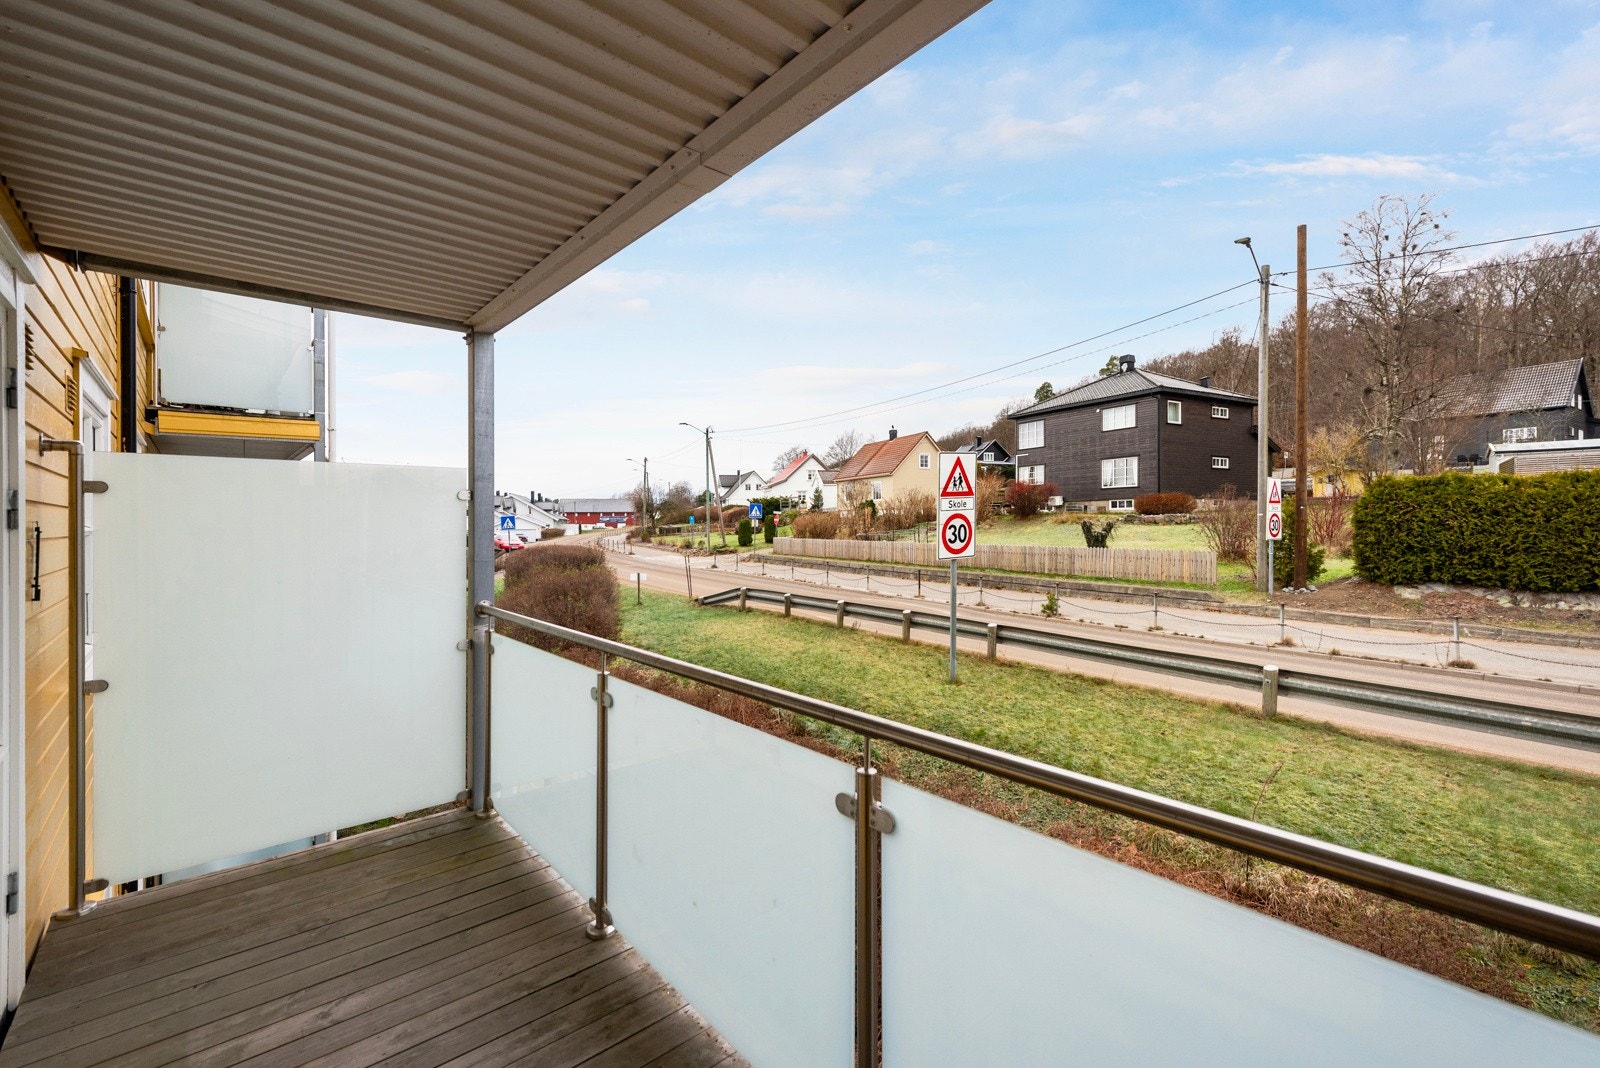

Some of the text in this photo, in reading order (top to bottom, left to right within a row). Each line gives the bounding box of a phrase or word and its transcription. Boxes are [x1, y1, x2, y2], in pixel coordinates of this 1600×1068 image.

[948, 500, 967, 509] Skole
[1271, 520, 1278, 531] 30
[948, 524, 967, 544] 30
